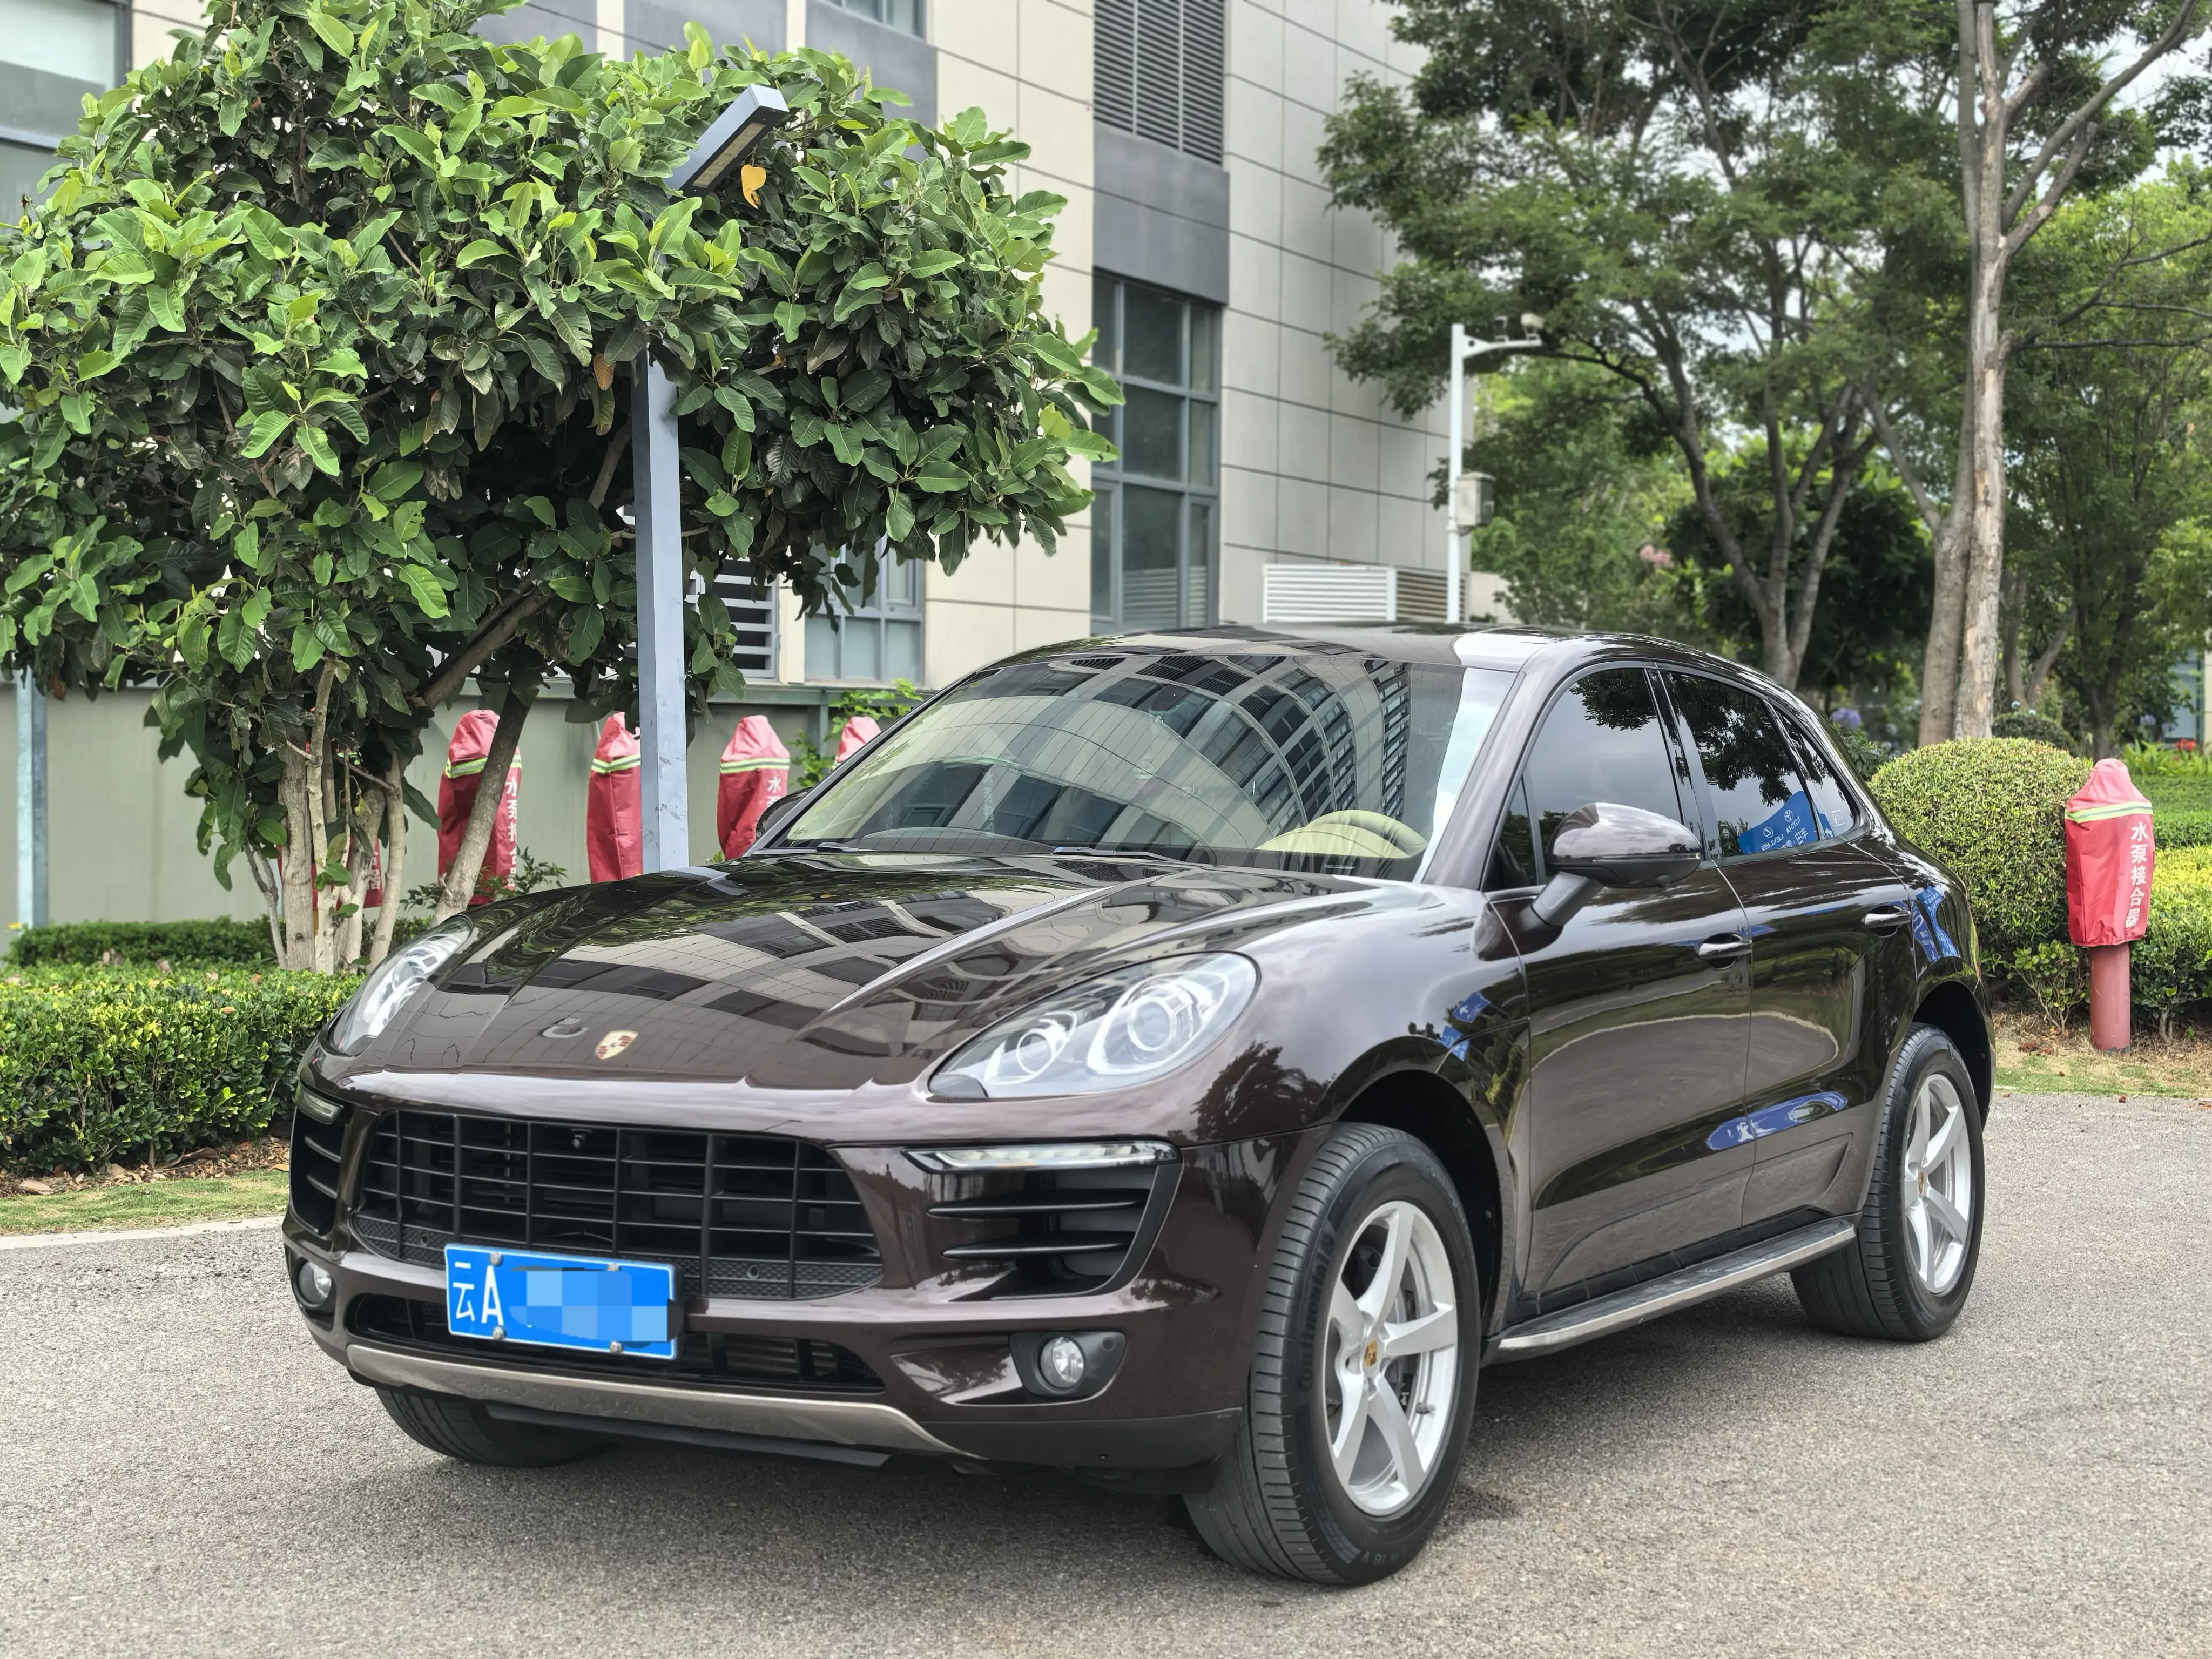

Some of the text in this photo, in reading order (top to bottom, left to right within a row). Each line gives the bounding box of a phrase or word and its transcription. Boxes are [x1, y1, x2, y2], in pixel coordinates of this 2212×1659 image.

[2126, 821, 2148, 928] 水泵接合器
